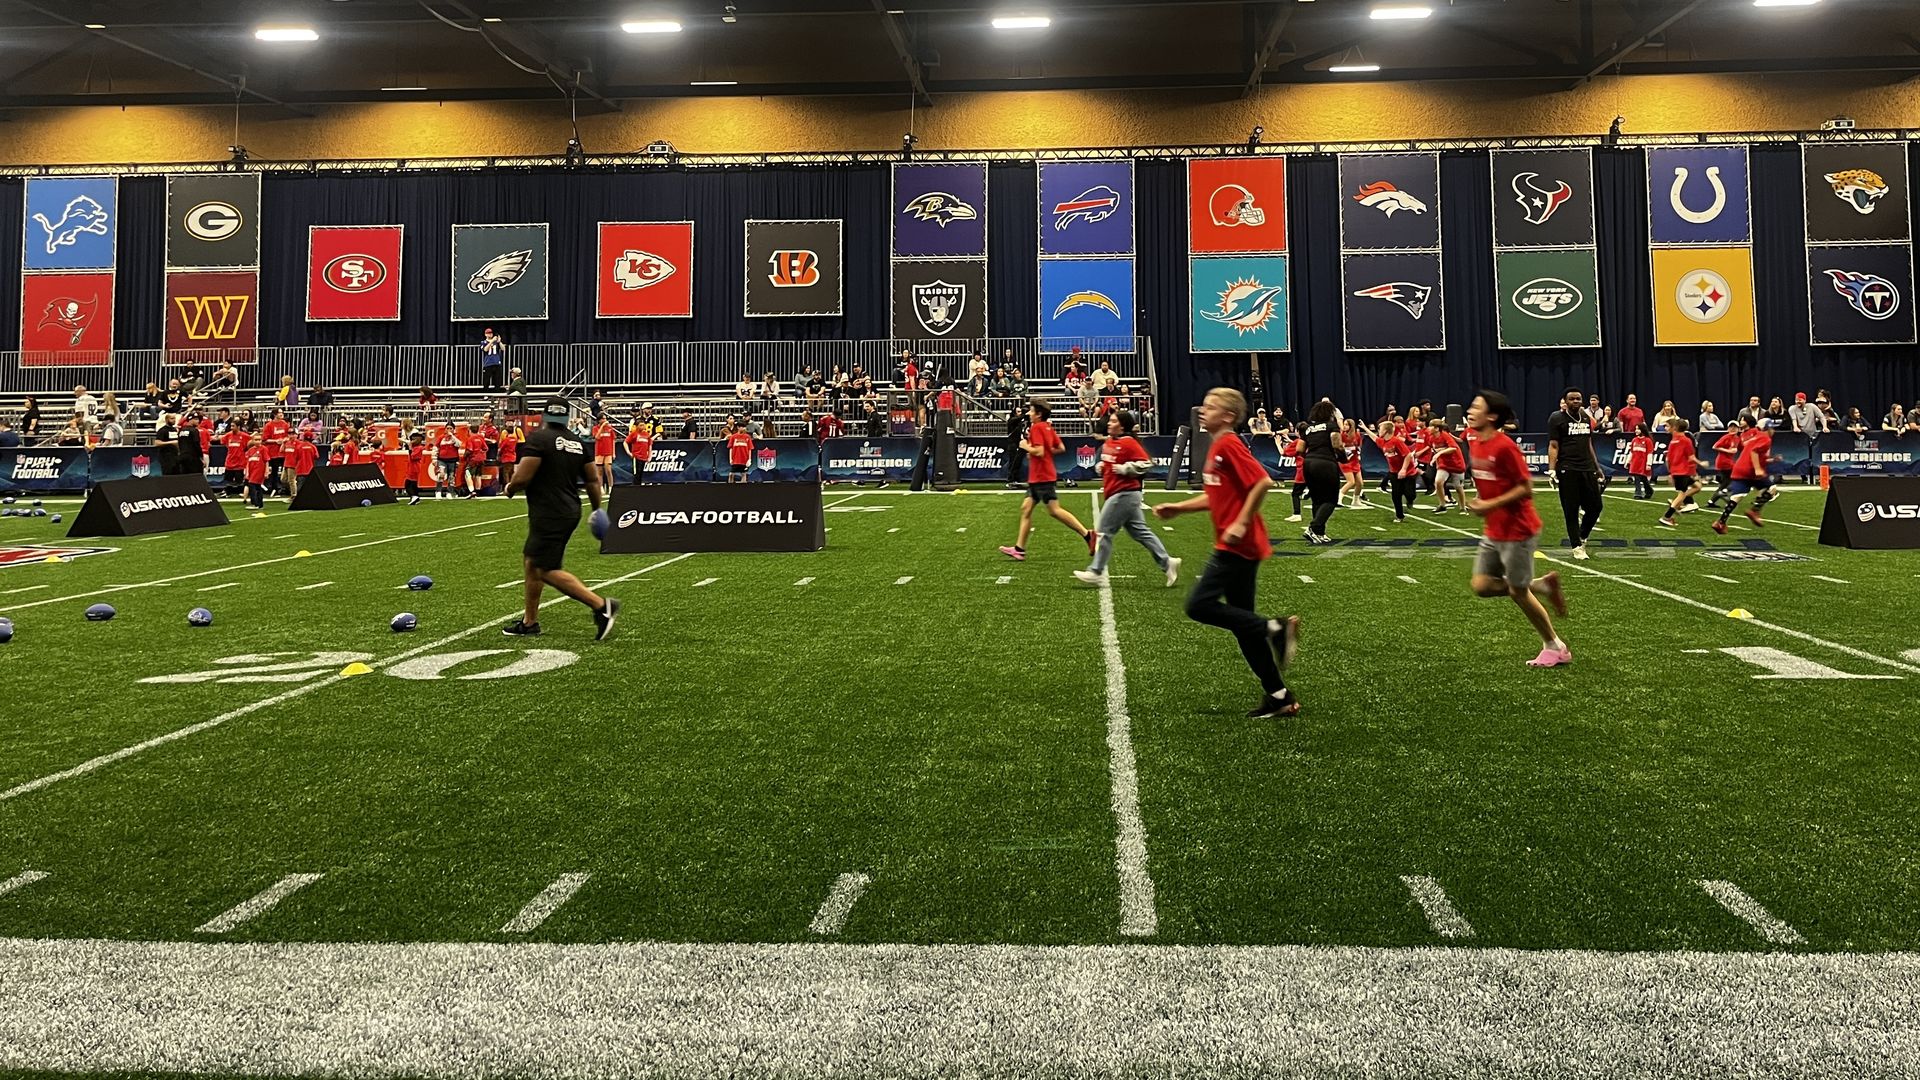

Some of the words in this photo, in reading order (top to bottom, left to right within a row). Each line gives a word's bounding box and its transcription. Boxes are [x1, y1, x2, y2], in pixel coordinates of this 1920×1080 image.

[187, 204, 240, 239] G
[628, 259, 661, 280] KC
[1521, 292, 1573, 305] JETS
[174, 295, 250, 339] W
[377, 430, 386, 438] G
[426, 429, 435, 438] G
[965, 446, 998, 459] PLAY
[1821, 453, 1912, 462] EXPERIENCE
[23, 456, 55, 469] PLAY
[643, 461, 685, 472] OOTBALL
[829, 458, 912, 468] EXPERIENCE
[956, 454, 1002, 468] FOOTBALL
[12, 464, 60, 479] FOOTBALL
[1876, 504, 1920, 519] US
